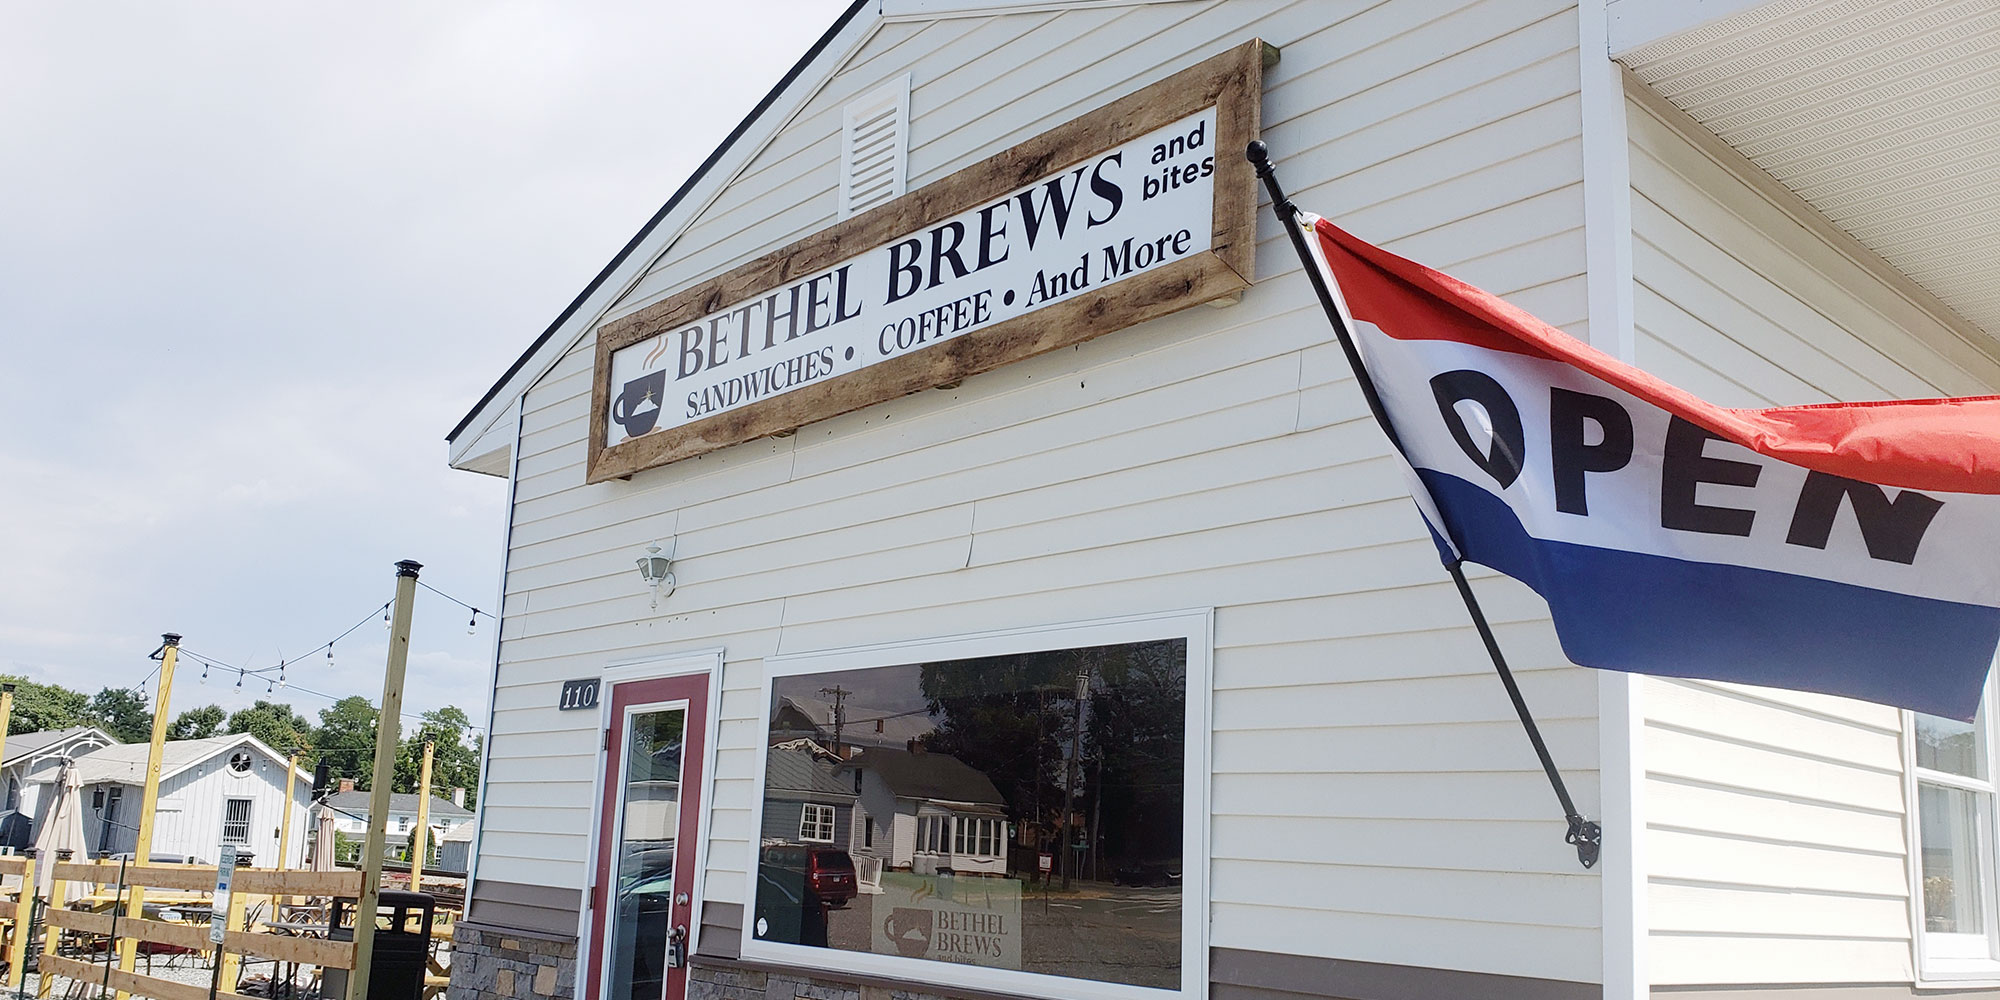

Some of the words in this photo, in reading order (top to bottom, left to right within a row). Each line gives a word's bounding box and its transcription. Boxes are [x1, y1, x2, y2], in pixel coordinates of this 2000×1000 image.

[1151, 119, 1206, 166] and
[1142, 156, 1215, 202] bites
[674, 263, 864, 382] BETHEL
[883, 150, 1124, 307] BREWS
[685, 345, 835, 420] SANDWICHES
[878, 288, 992, 357] COFFEE
[1024, 251, 1091, 309] And
[1100, 228, 1193, 284] More
[1428, 368, 1946, 566] OPEN
[563, 684, 594, 709] 110
[937, 909, 1009, 936] BETHEL
[937, 931, 1002, 958] BREWS
